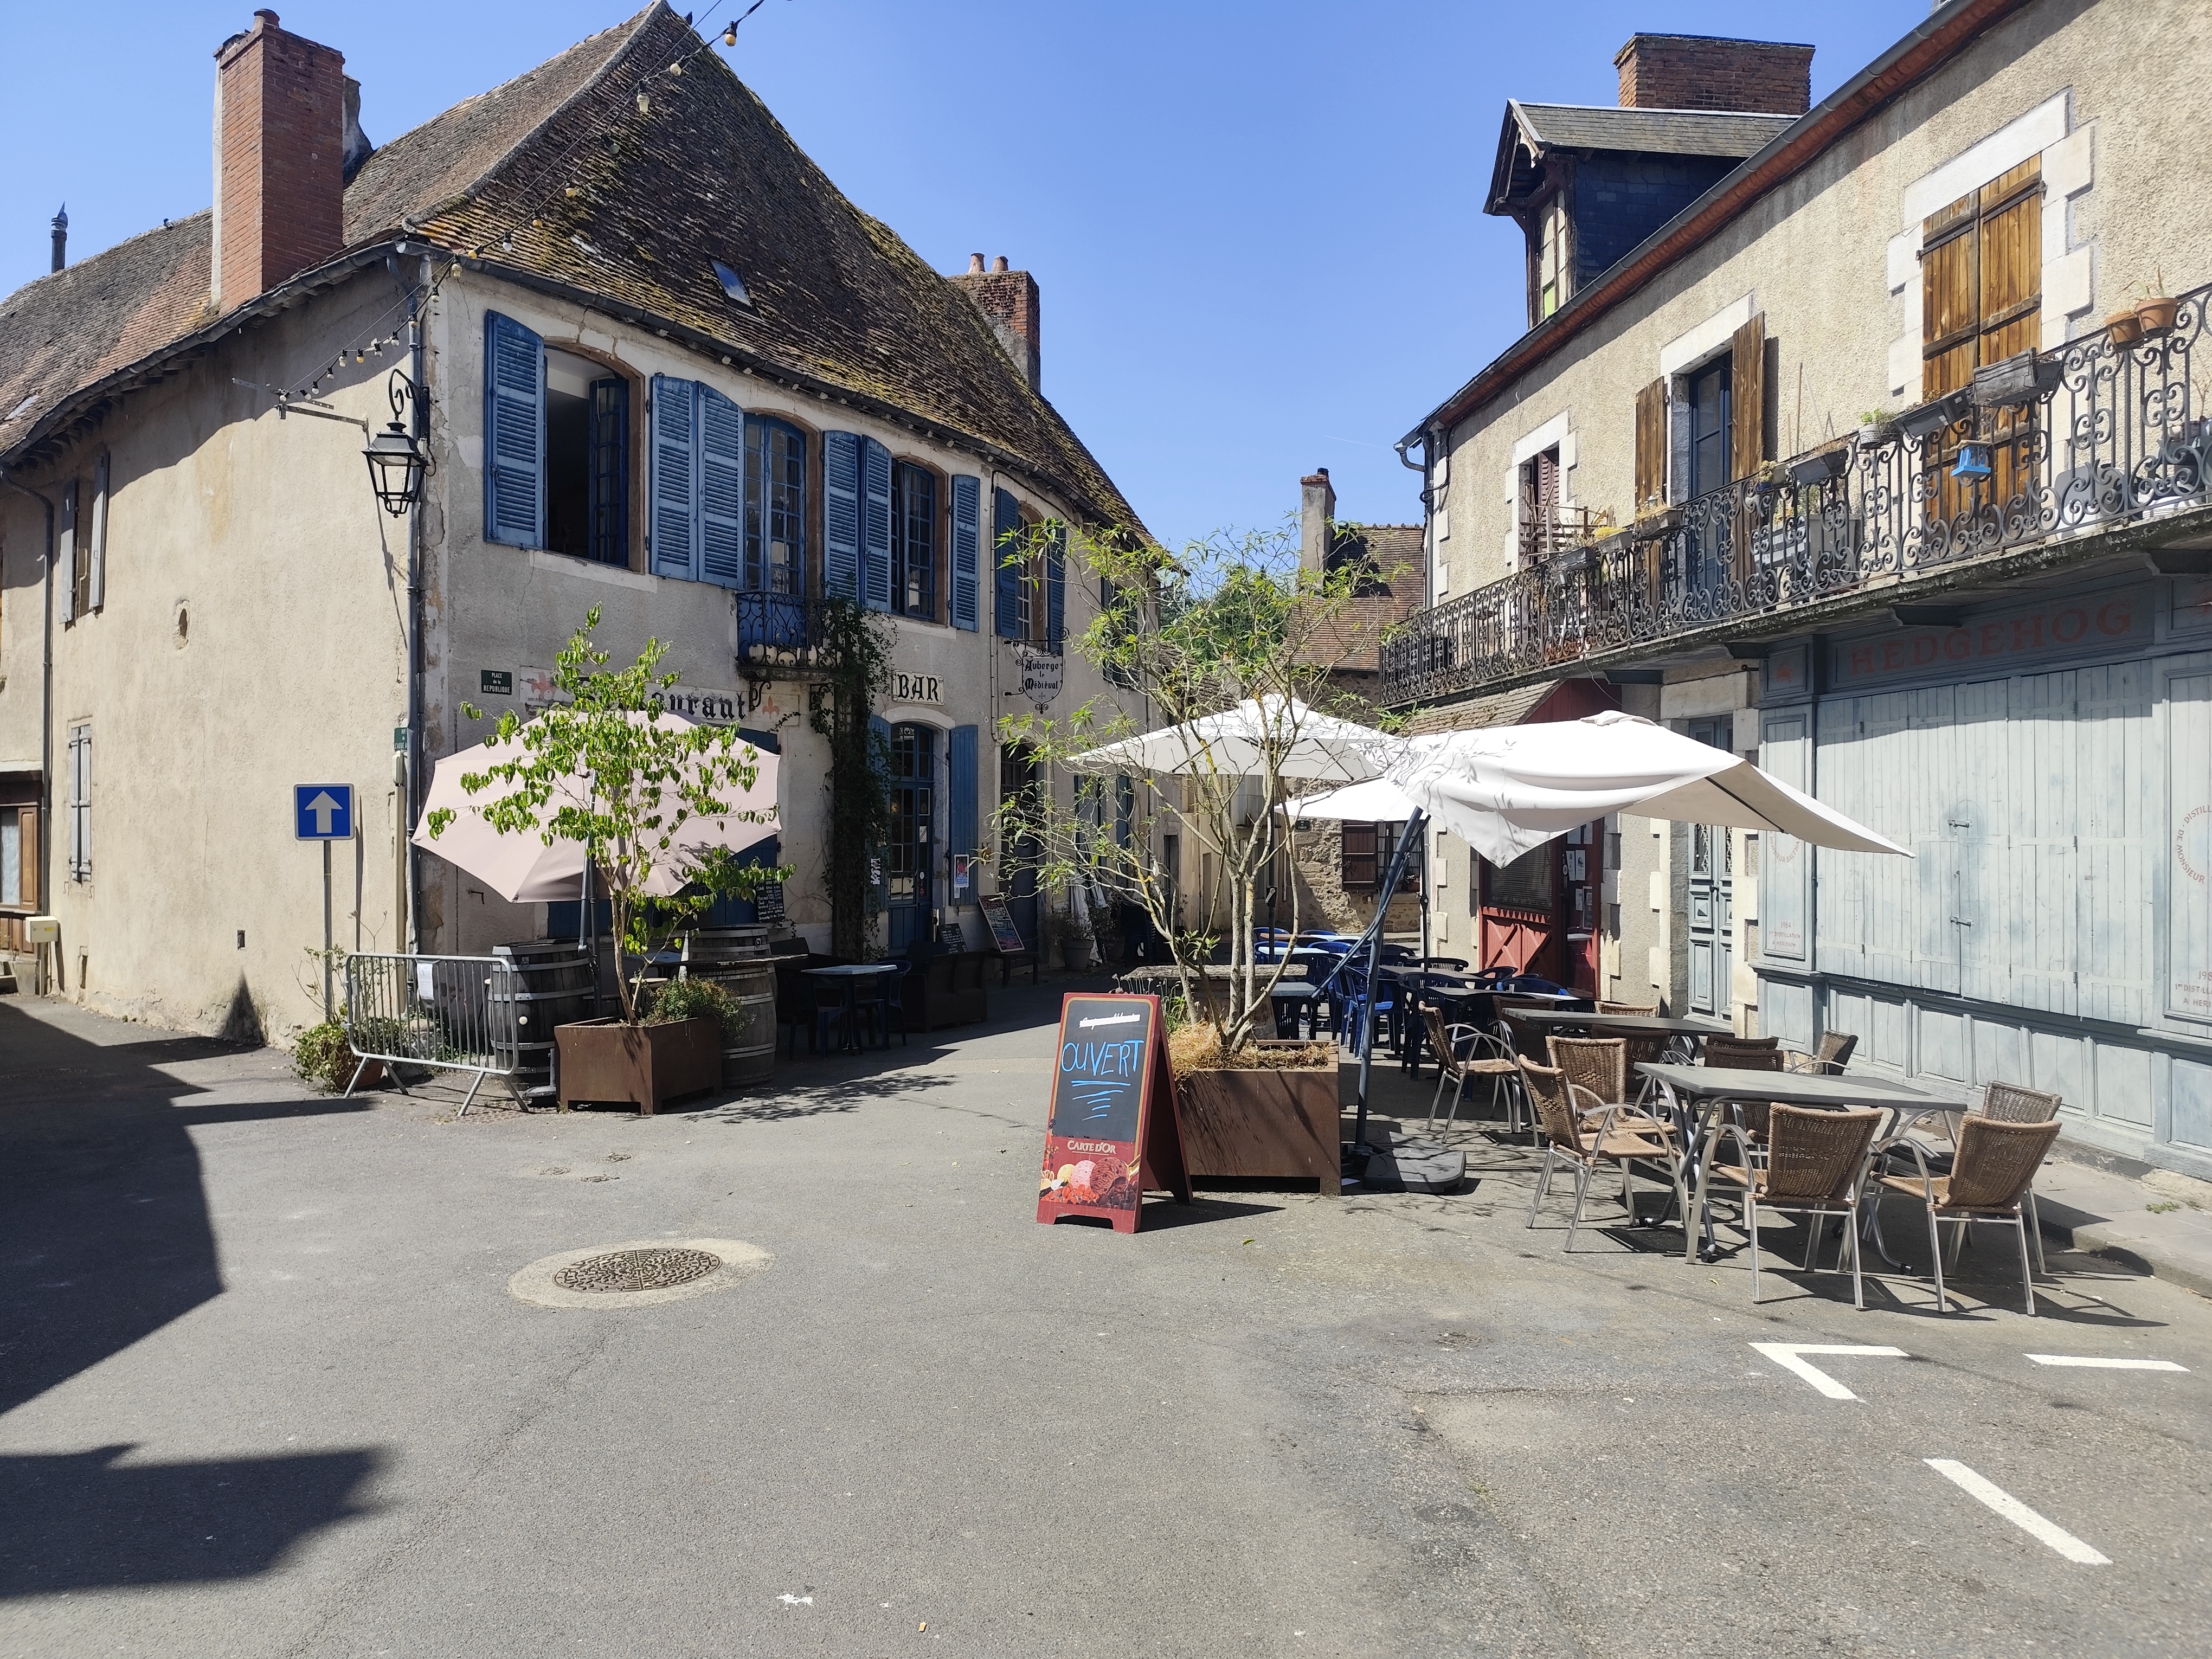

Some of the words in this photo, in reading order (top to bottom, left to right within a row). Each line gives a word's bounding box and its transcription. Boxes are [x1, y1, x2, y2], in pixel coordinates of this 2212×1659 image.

[1850, 599, 2132, 676] HEDGEHOG
[1024, 659, 1059, 672] Auberge
[483, 684, 510, 693] REPUBLIQUE
[897, 674, 939, 702] BAR
[1024, 678, 1059, 691] Médiéval
[2177, 829, 2185, 841] DE
[1769, 837, 1786, 863] MONSIEUR
[1786, 839, 1800, 863] BALTHA
[2176, 845, 2205, 884] MONSIEUR
[1061, 1039, 1144, 1077] OUVERT
[1067, 1140, 1095, 1152] CARTE
[1095, 1142, 1117, 1155] D'OR
